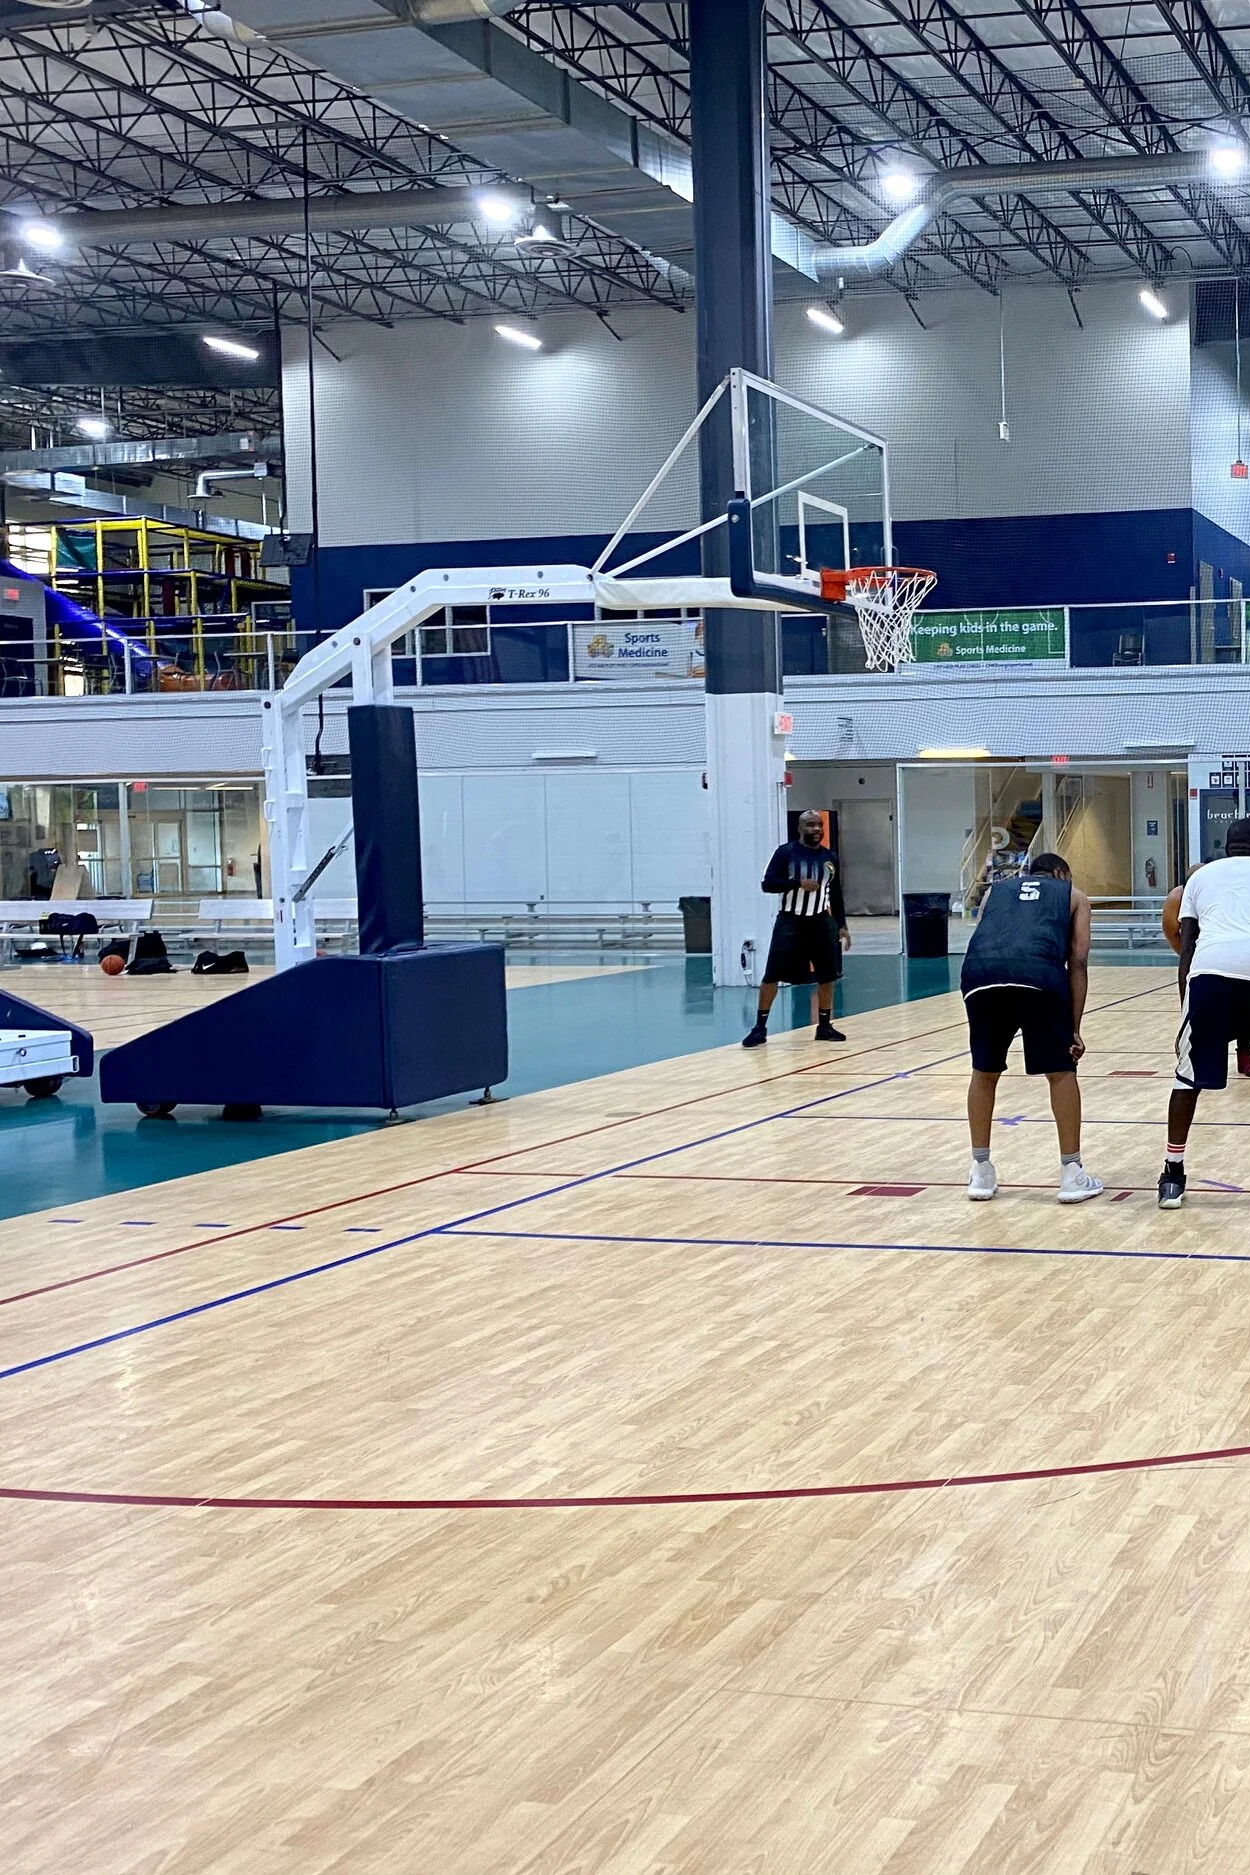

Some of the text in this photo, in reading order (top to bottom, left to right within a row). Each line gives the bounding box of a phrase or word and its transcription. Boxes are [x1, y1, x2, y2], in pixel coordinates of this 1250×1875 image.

[508, 589, 537, 598] T-Rex
[538, 588, 550, 598] 96
[960, 622, 983, 634] kids
[986, 622, 997, 633] in
[999, 621, 1018, 632] the
[1022, 621, 1058, 634] game.
[625, 633, 660, 645] Sports
[618, 647, 668, 658] Medicine
[955, 644, 1026, 656] Sports Medicine
[1019, 881, 1040, 900] 5
